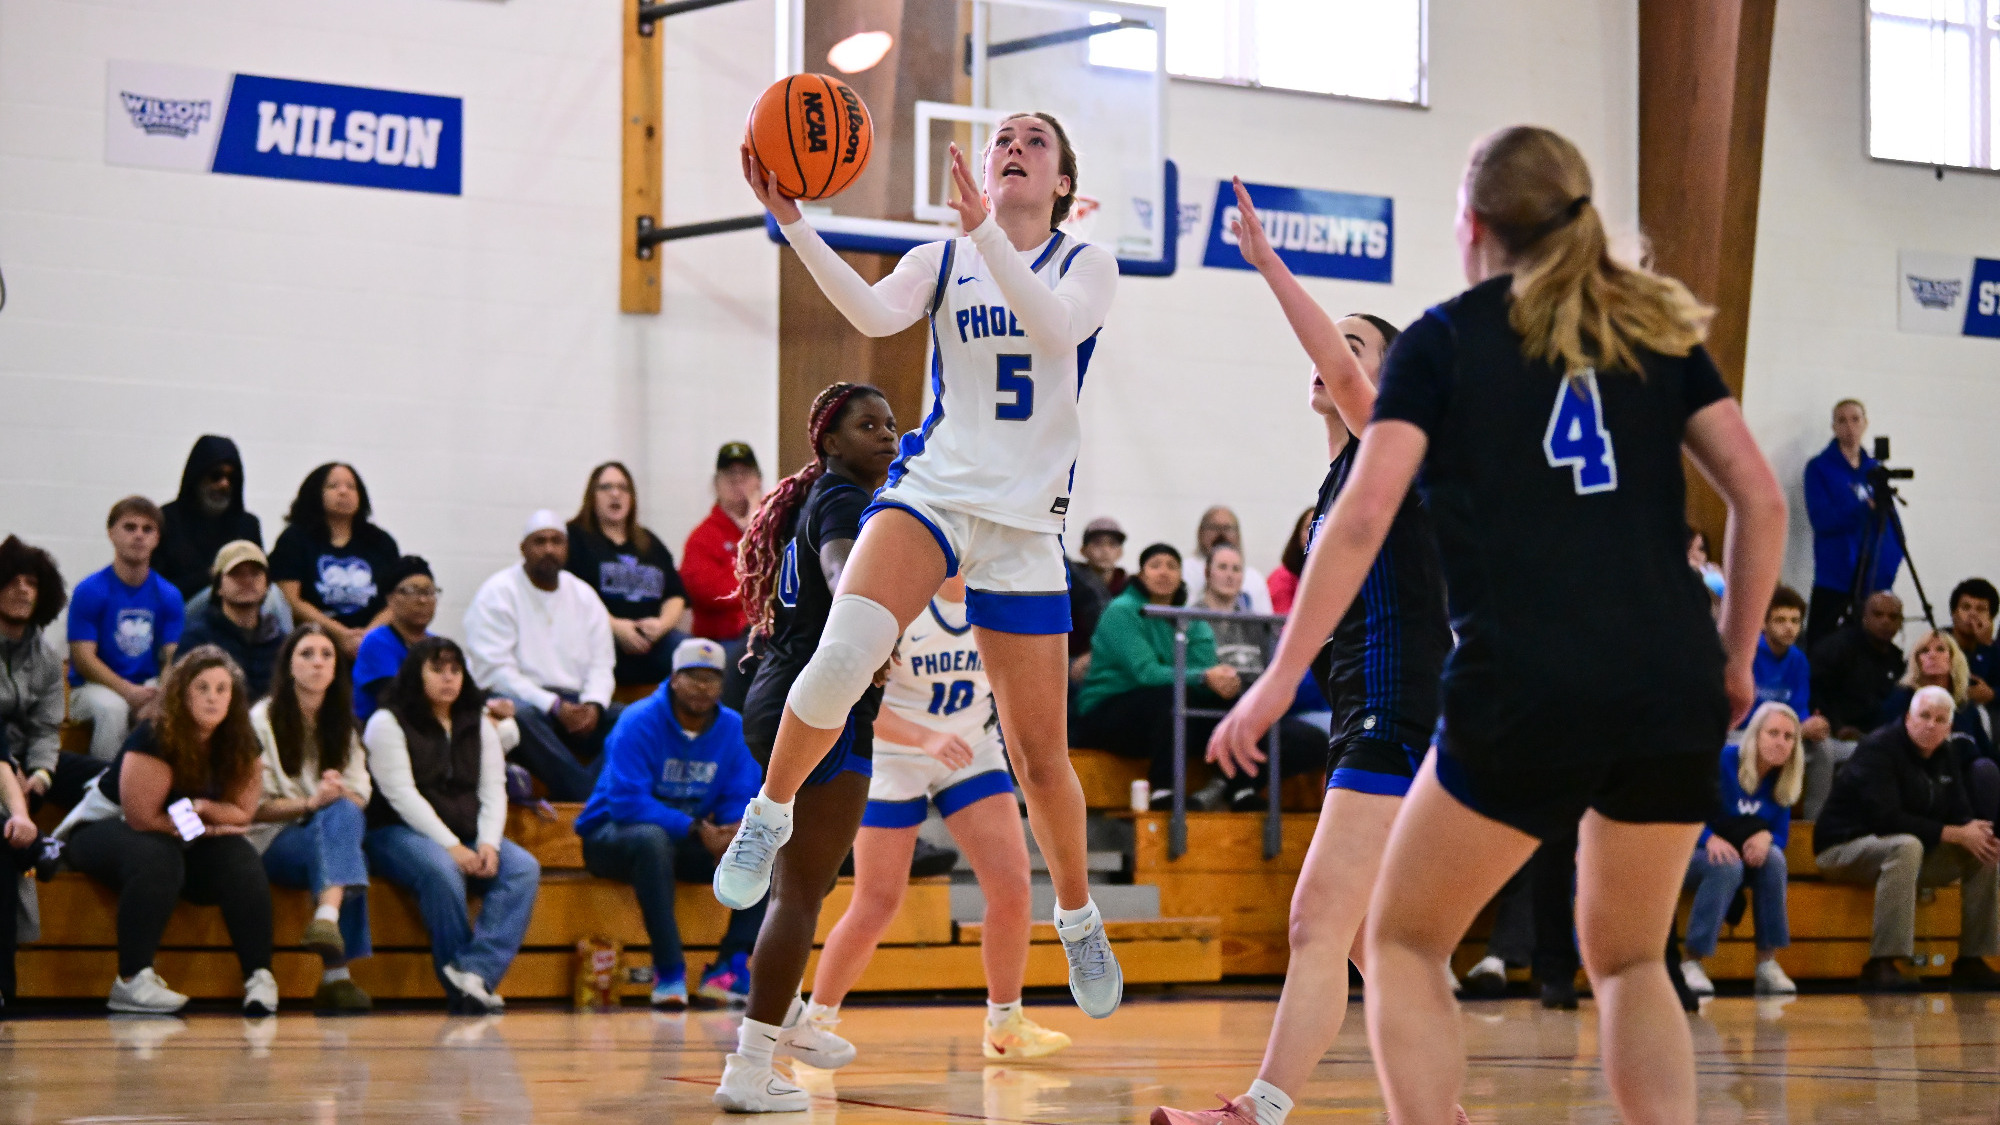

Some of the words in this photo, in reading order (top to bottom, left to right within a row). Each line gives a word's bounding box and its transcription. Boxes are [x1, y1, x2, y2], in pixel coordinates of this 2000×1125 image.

[256, 101, 442, 169] WILSON
[802, 91, 828, 153] NCAA
[837, 86, 864, 164] Wilson
[1220, 205, 1388, 259] SUDENTS
[956, 304, 1028, 343] PHOE
[995, 353, 1034, 421] 5
[1543, 366, 1618, 495] 4
[911, 650, 984, 676] PHOENI
[928, 680, 975, 716] 10
[1738, 799, 1761, 815] W
